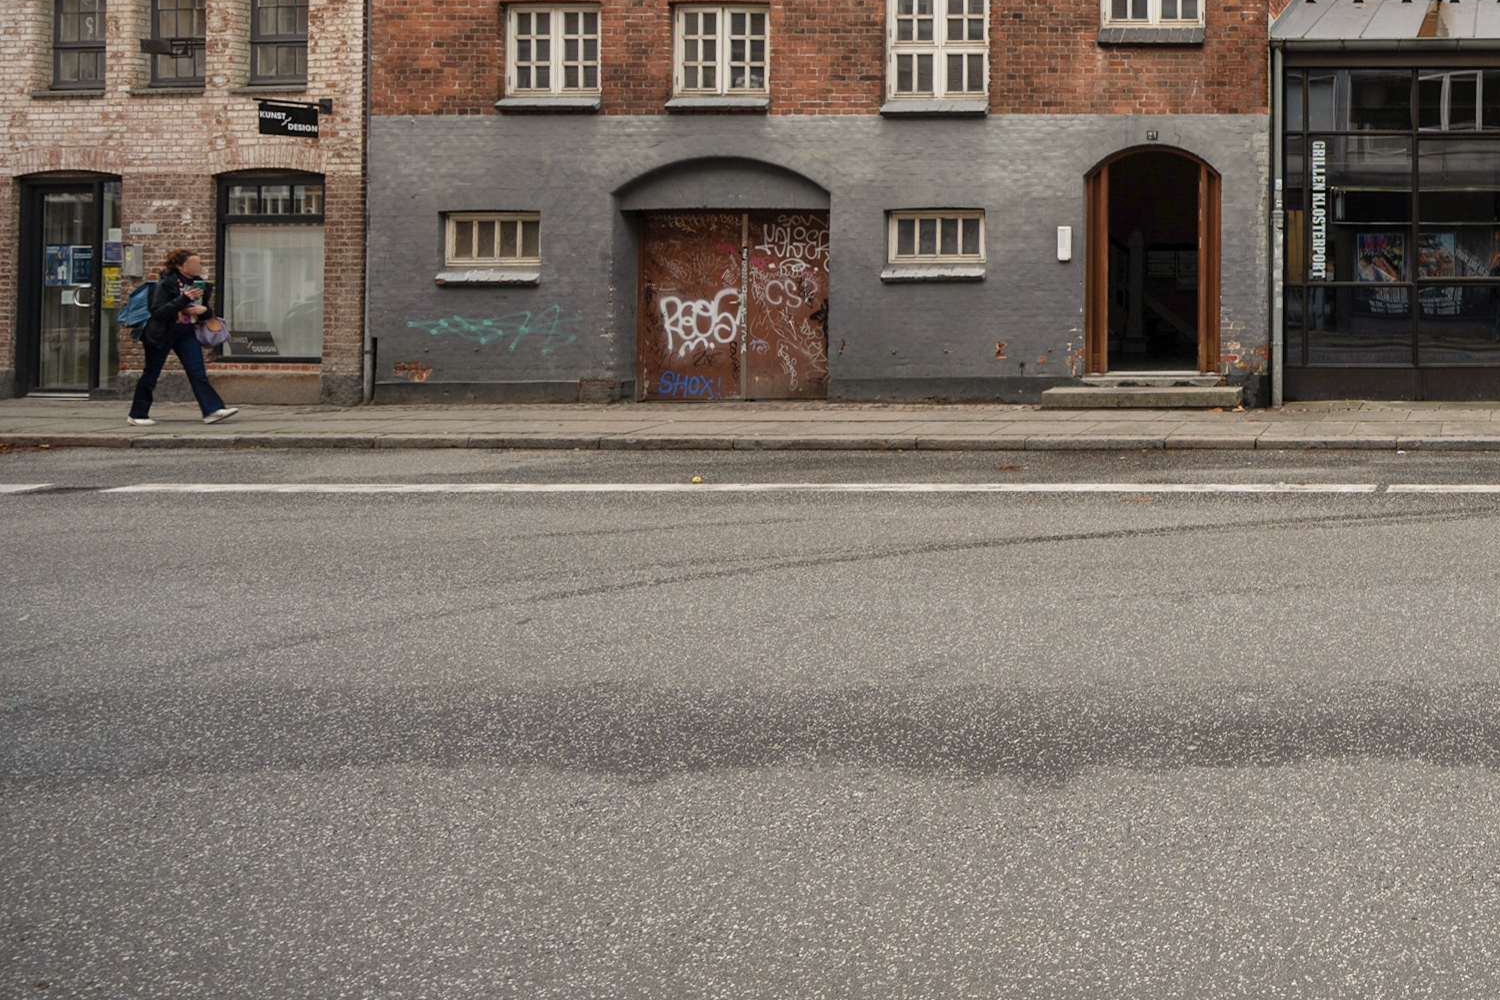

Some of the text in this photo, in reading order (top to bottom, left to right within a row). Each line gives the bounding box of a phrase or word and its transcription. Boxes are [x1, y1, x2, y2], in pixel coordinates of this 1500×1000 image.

[259, 110, 287, 120] KUNST
[287, 123, 318, 133] DESIGN
[1312, 141, 1327, 279] GRILLEN KLOSTERPORT
[658, 370, 722, 399] SHOX!
